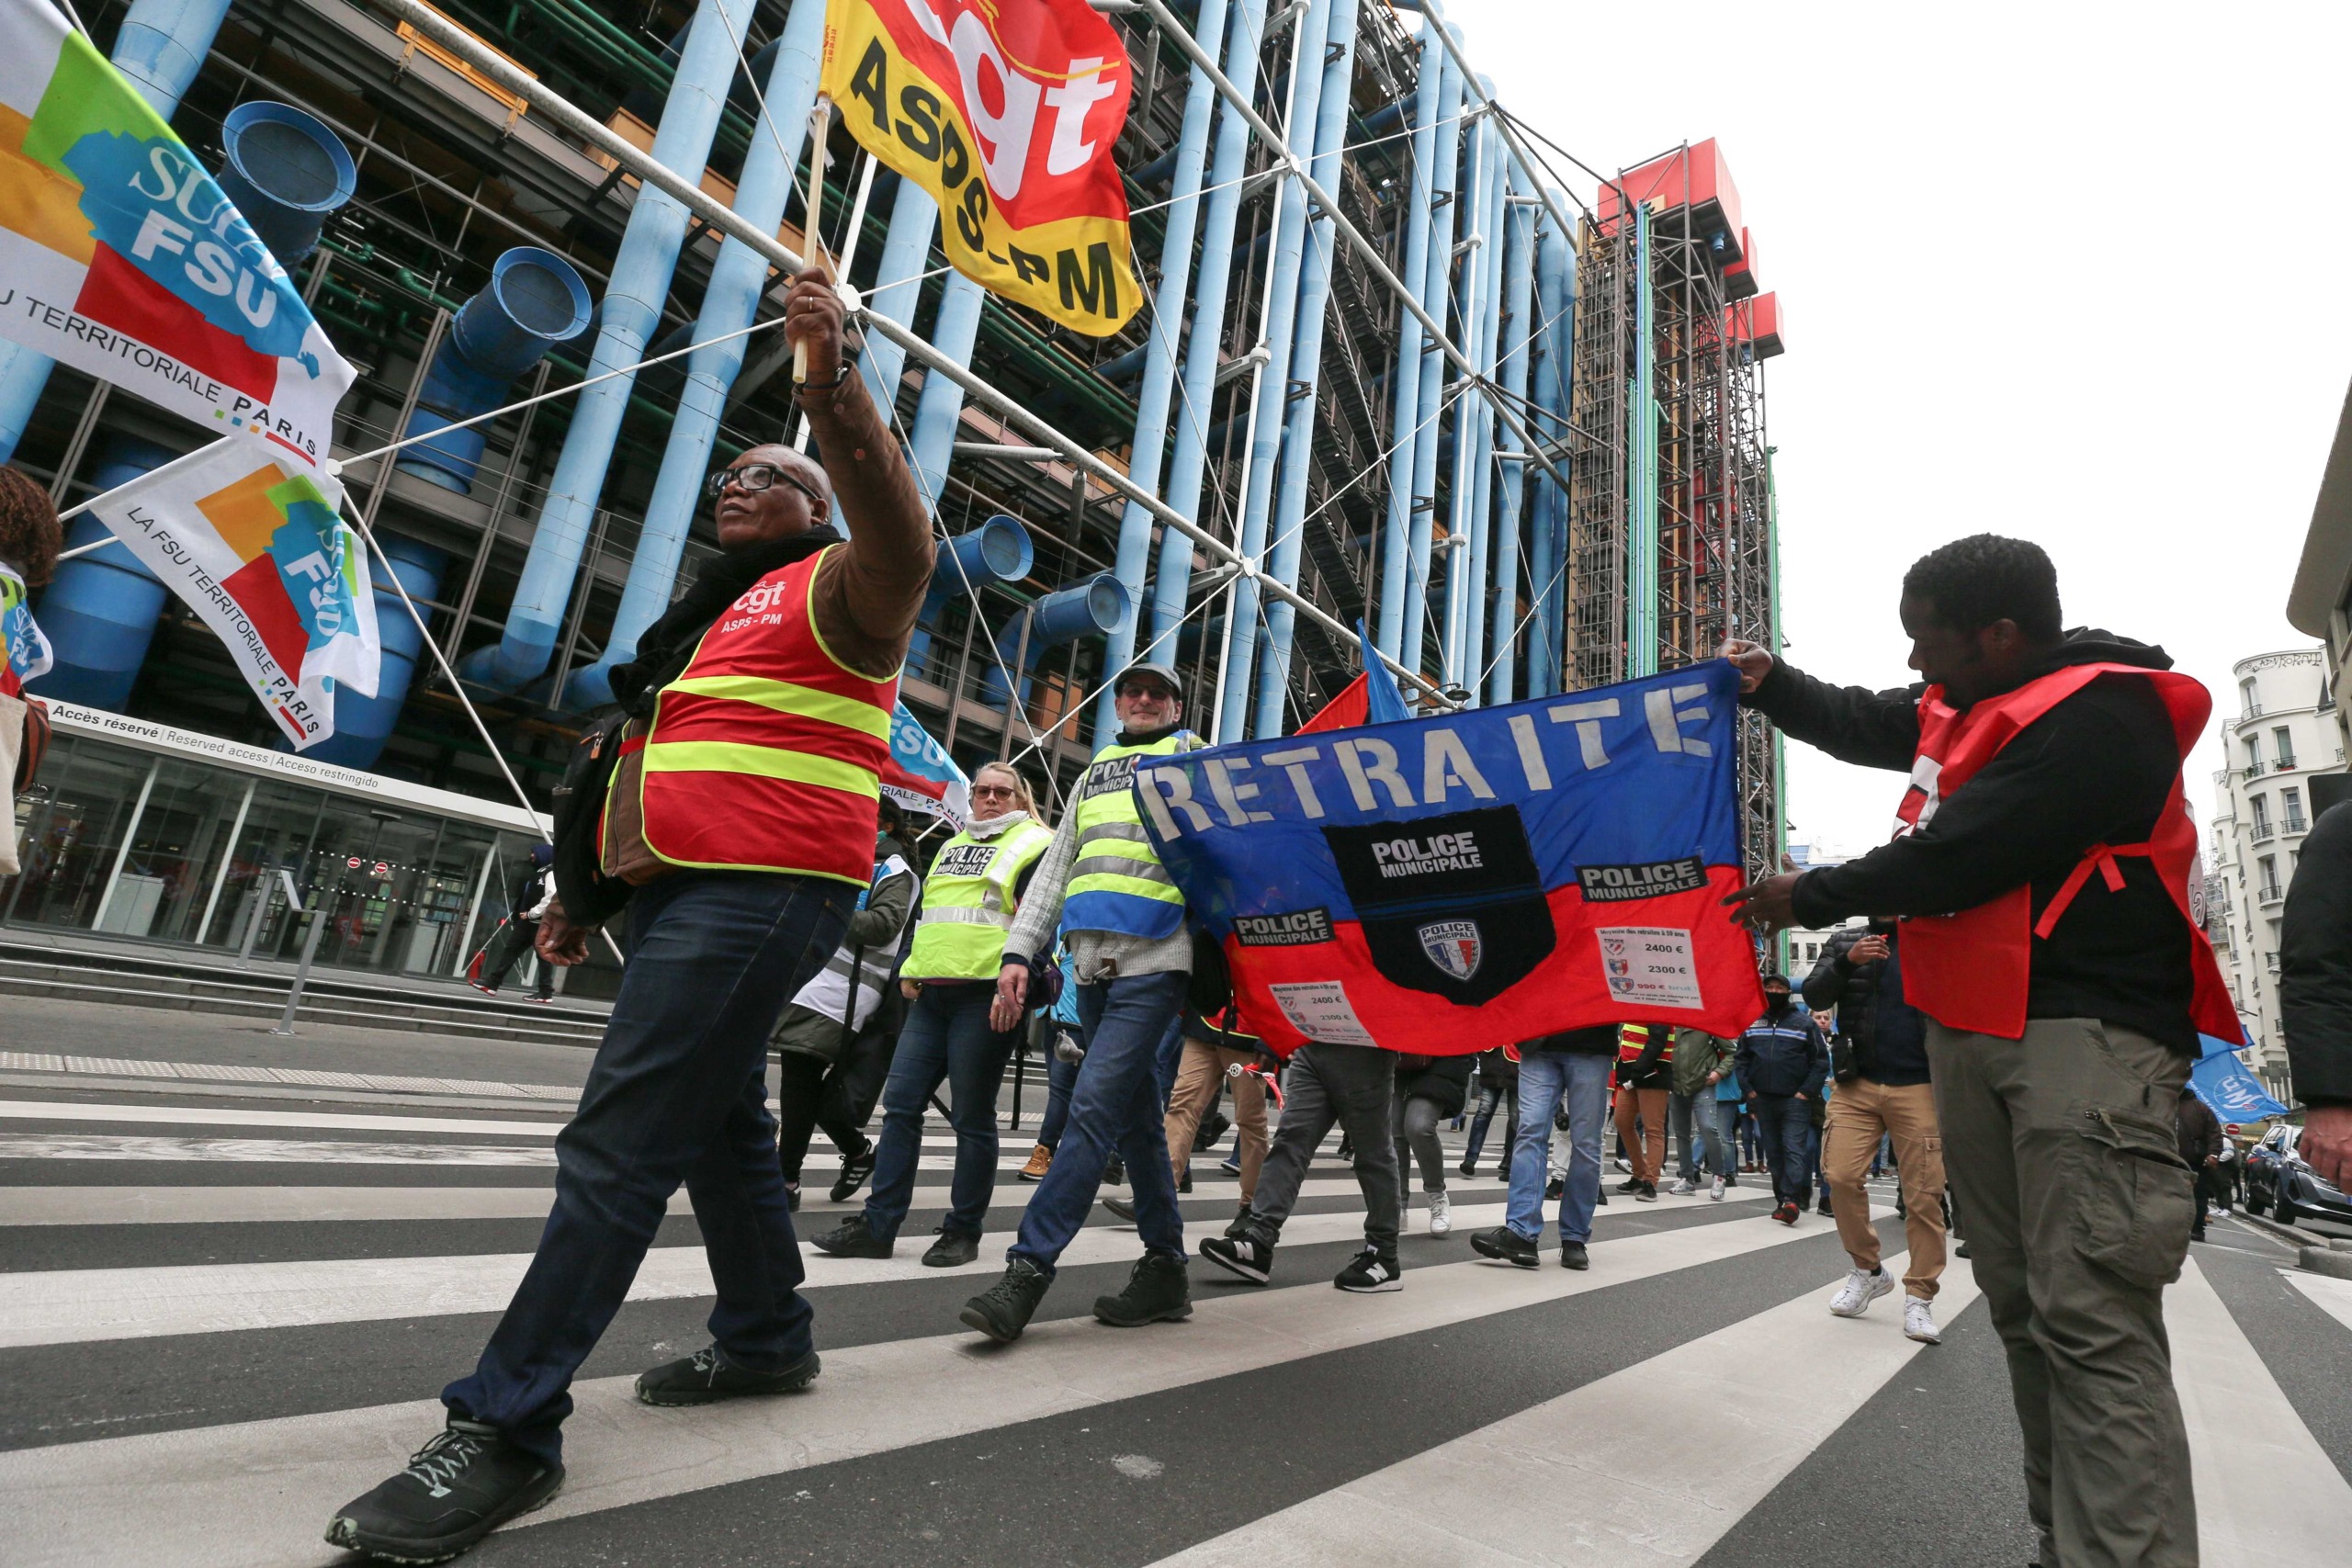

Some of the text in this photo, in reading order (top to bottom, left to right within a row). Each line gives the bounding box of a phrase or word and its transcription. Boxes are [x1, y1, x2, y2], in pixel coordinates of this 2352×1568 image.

[131, 209, 277, 328] FSU
[26, 296, 222, 402] TERRITORIALE
[232, 395, 317, 456] PARIS
[733, 581, 786, 614] cgt
[127, 506, 320, 734] LA FSU TERRITORIALE PARIS
[721, 616, 752, 633] ASPS
[761, 614, 783, 625] PM
[52, 705, 379, 789] Accès réservé Reserved access Acceso restringido
[1137, 682, 1713, 842] RETRAITE
[941, 846, 995, 863] POLICE
[1371, 831, 1479, 864] POLICE
[1379, 853, 1484, 878] MUNICIPALE
[1582, 861, 1697, 887] POLICE
[1588, 876, 1701, 899] MUNICIPALE
[1236, 909, 1326, 934] POLICE
[1420, 923, 1475, 938] POLICE
[1242, 928, 1329, 944] MUNICIPALE
[1424, 931, 1476, 944] MUNICIPALE
[1645, 943, 1683, 953] 2400 €
[1648, 965, 1676, 974] 2300
[1233, 1240, 1254, 1260] N
[1365, 1262, 1388, 1282] N
